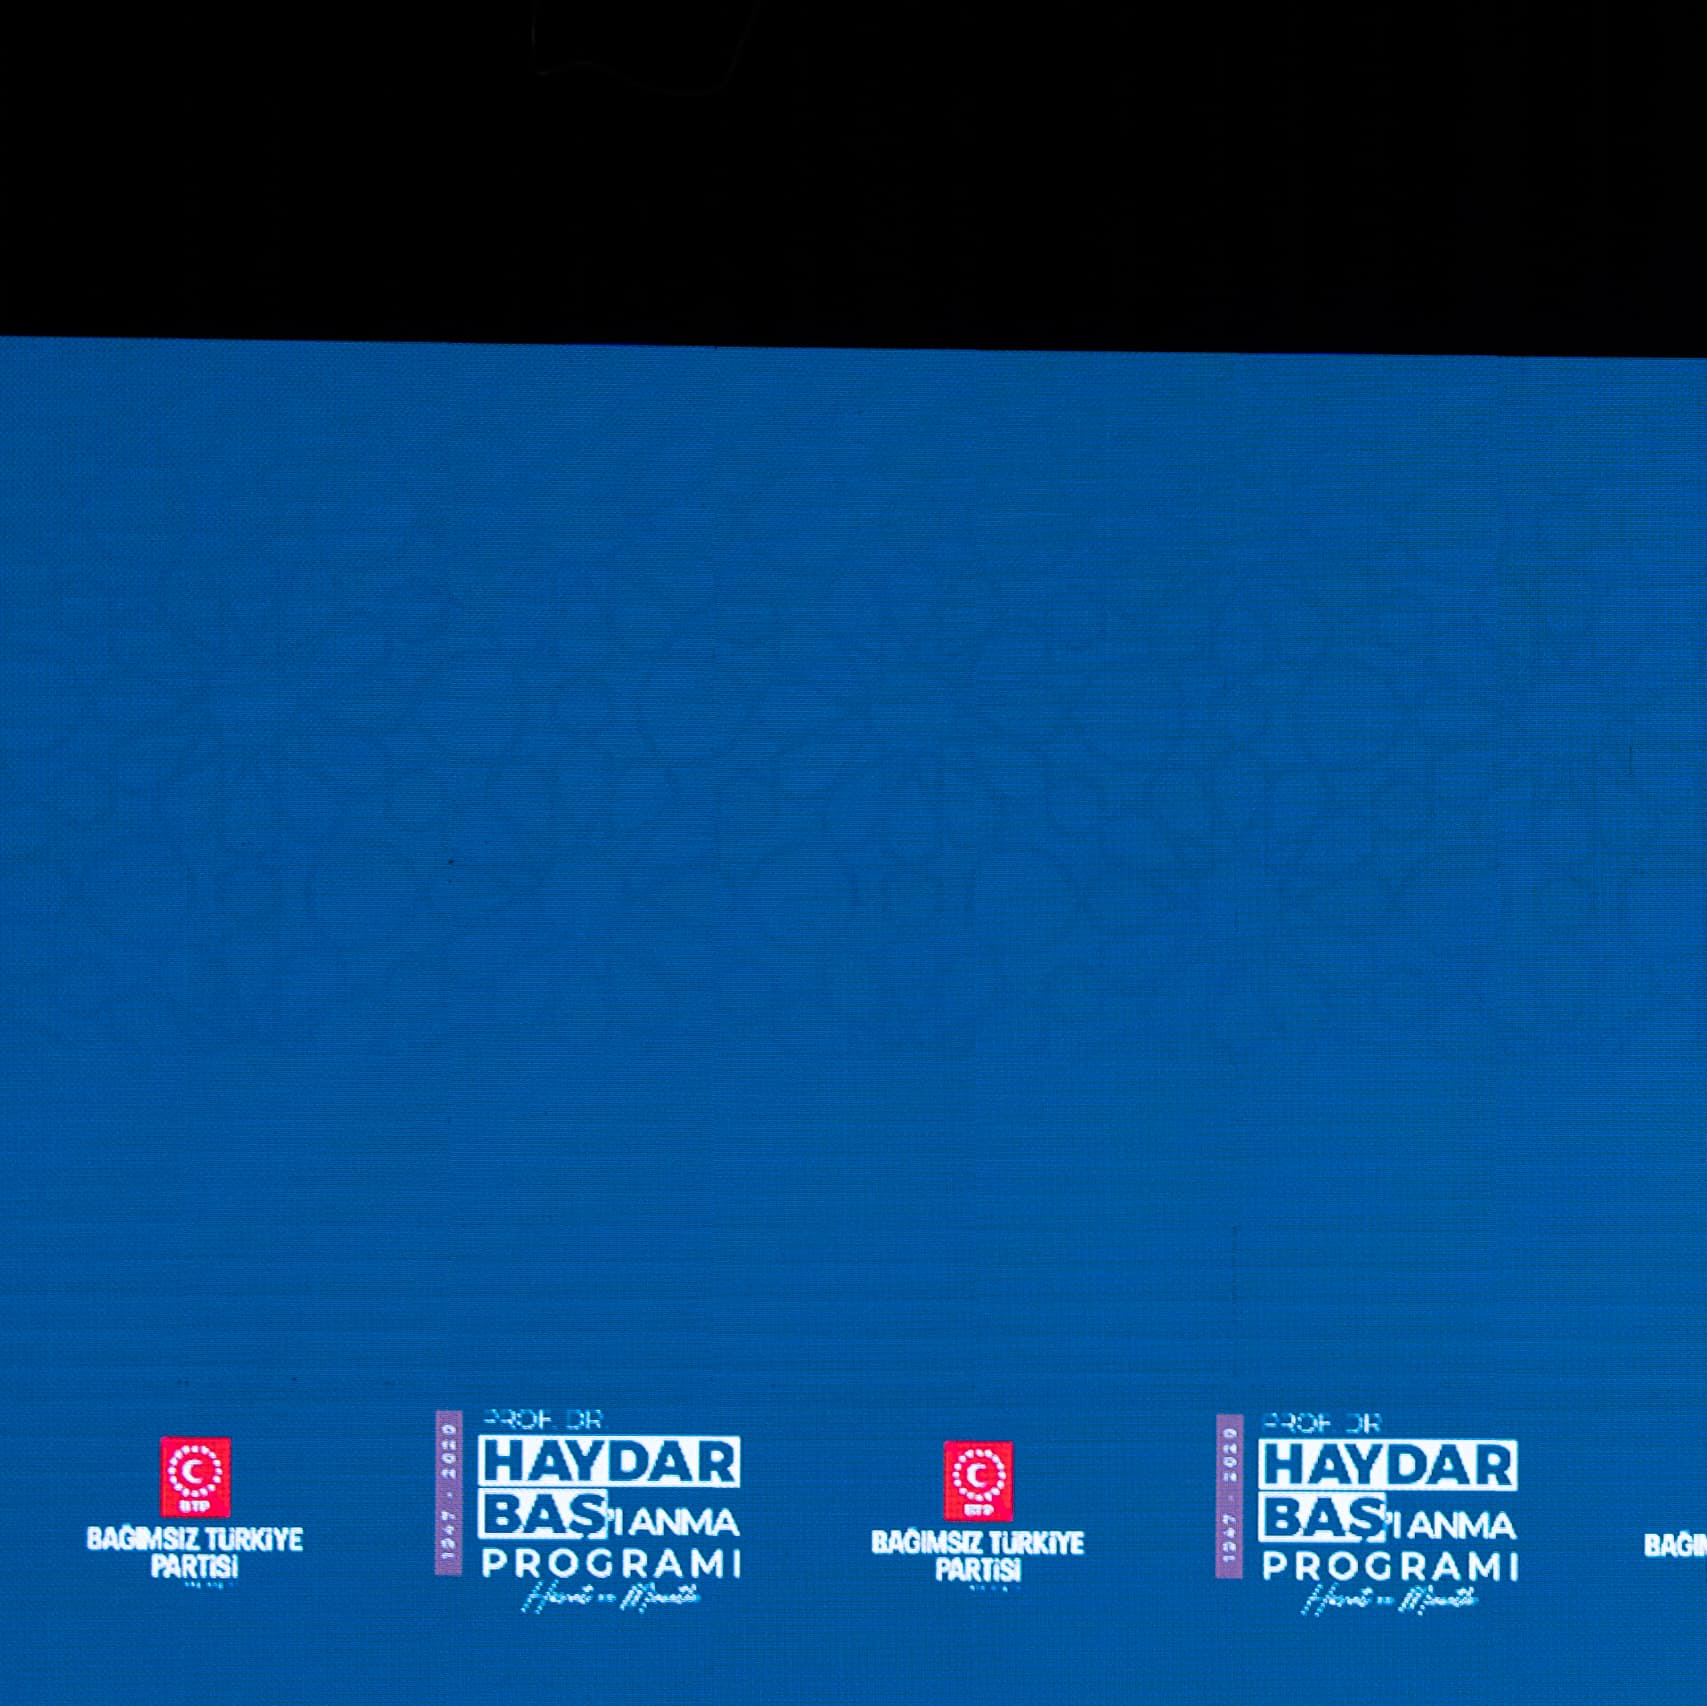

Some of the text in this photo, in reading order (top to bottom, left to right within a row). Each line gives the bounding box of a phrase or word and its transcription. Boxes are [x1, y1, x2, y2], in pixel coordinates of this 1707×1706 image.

[484, 1440, 734, 1481] HAYDAR
[1264, 1444, 1511, 1485] HAYDAR
[629, 1509, 739, 1536] ANMA
[1408, 1512, 1516, 1539] ANMA
[483, 1549, 740, 1578] PROGRAMI
[1264, 1551, 1517, 1580] PROGRAMI
